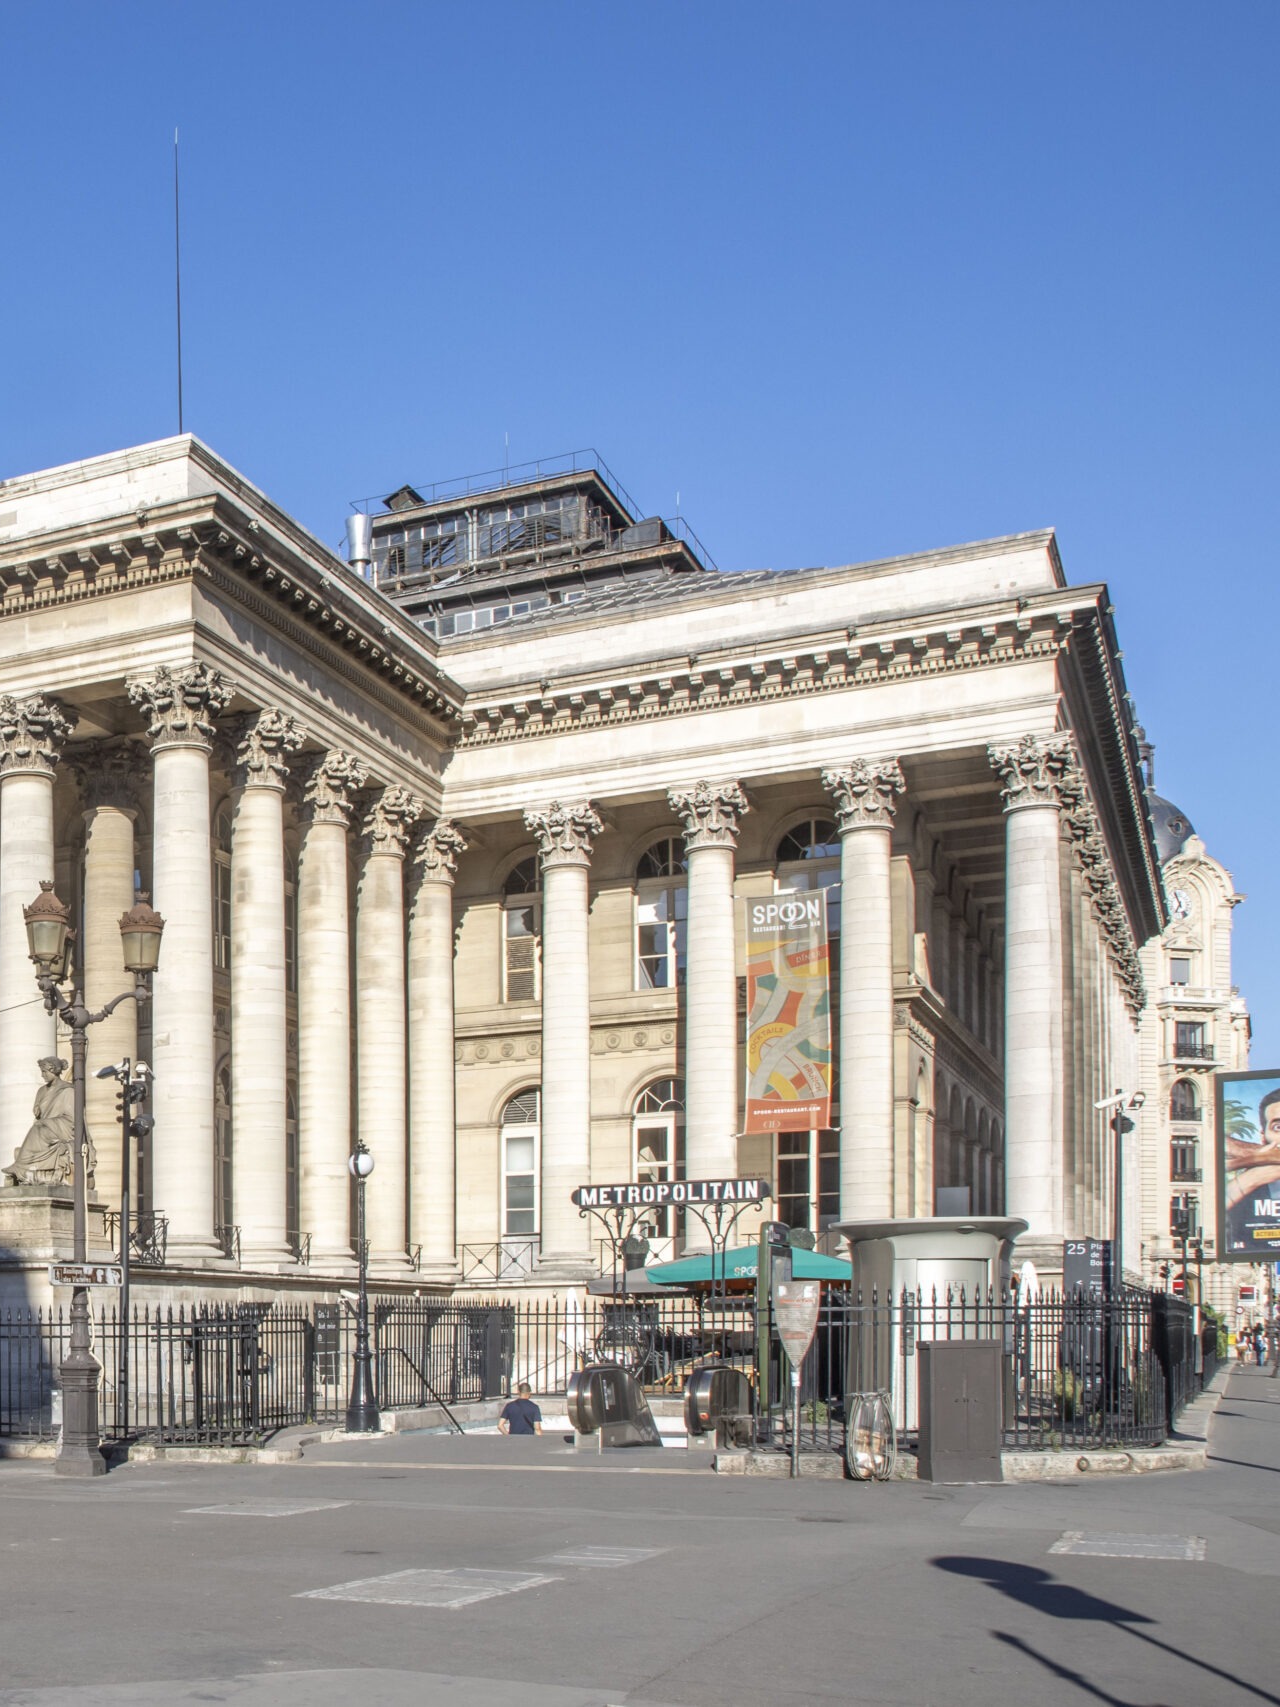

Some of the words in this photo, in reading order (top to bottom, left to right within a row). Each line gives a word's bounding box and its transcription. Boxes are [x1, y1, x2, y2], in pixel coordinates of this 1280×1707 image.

[753, 899, 819, 925] SPOON
[581, 1180, 759, 1206] METROPOLITAIN
[1067, 1243, 1086, 1255] 25
[318, 1310, 329, 1318] Grad
